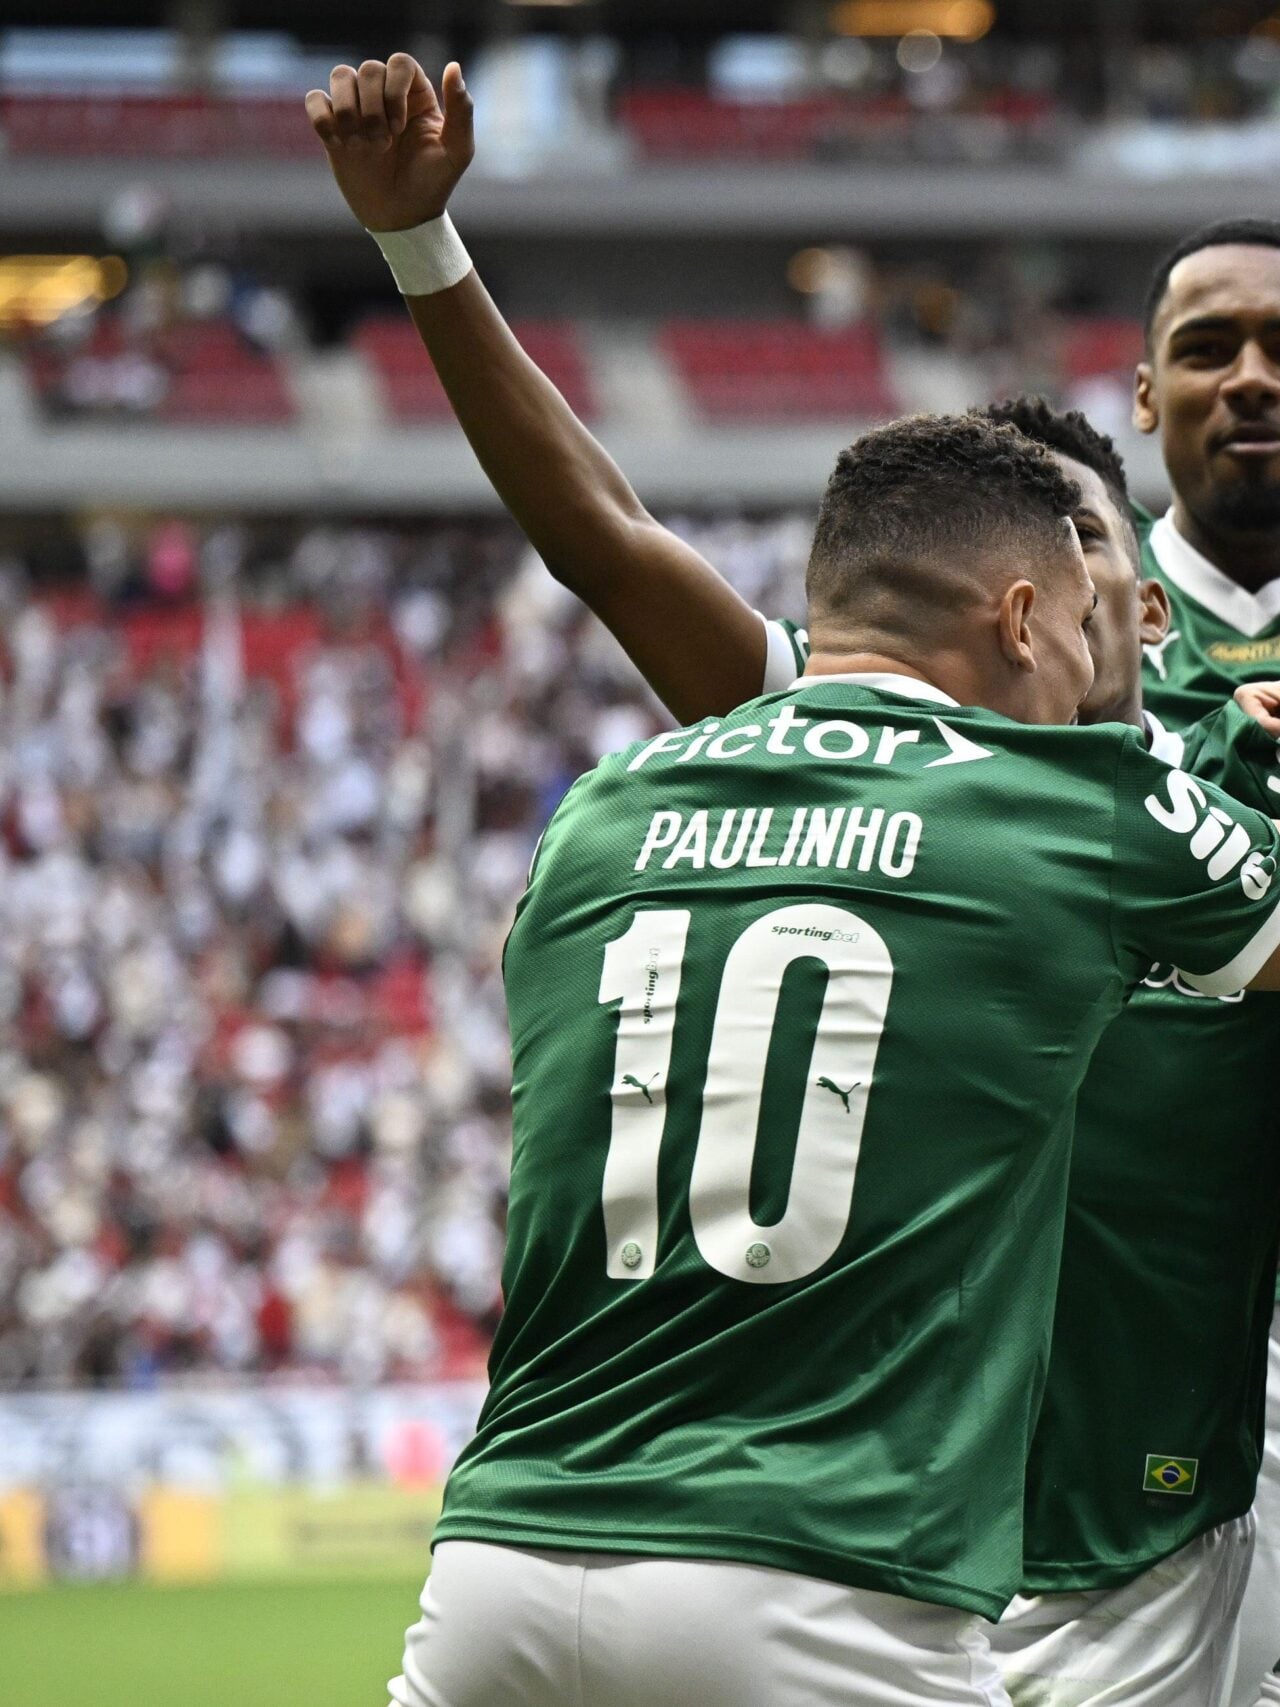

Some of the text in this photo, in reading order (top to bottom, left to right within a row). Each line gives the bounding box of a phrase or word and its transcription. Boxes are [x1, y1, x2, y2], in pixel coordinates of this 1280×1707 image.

[626, 706, 920, 771] Fictor
[634, 807, 922, 878] PAULINHO
[771, 925, 860, 943] sportingbet
[599, 905, 894, 1284] 10
